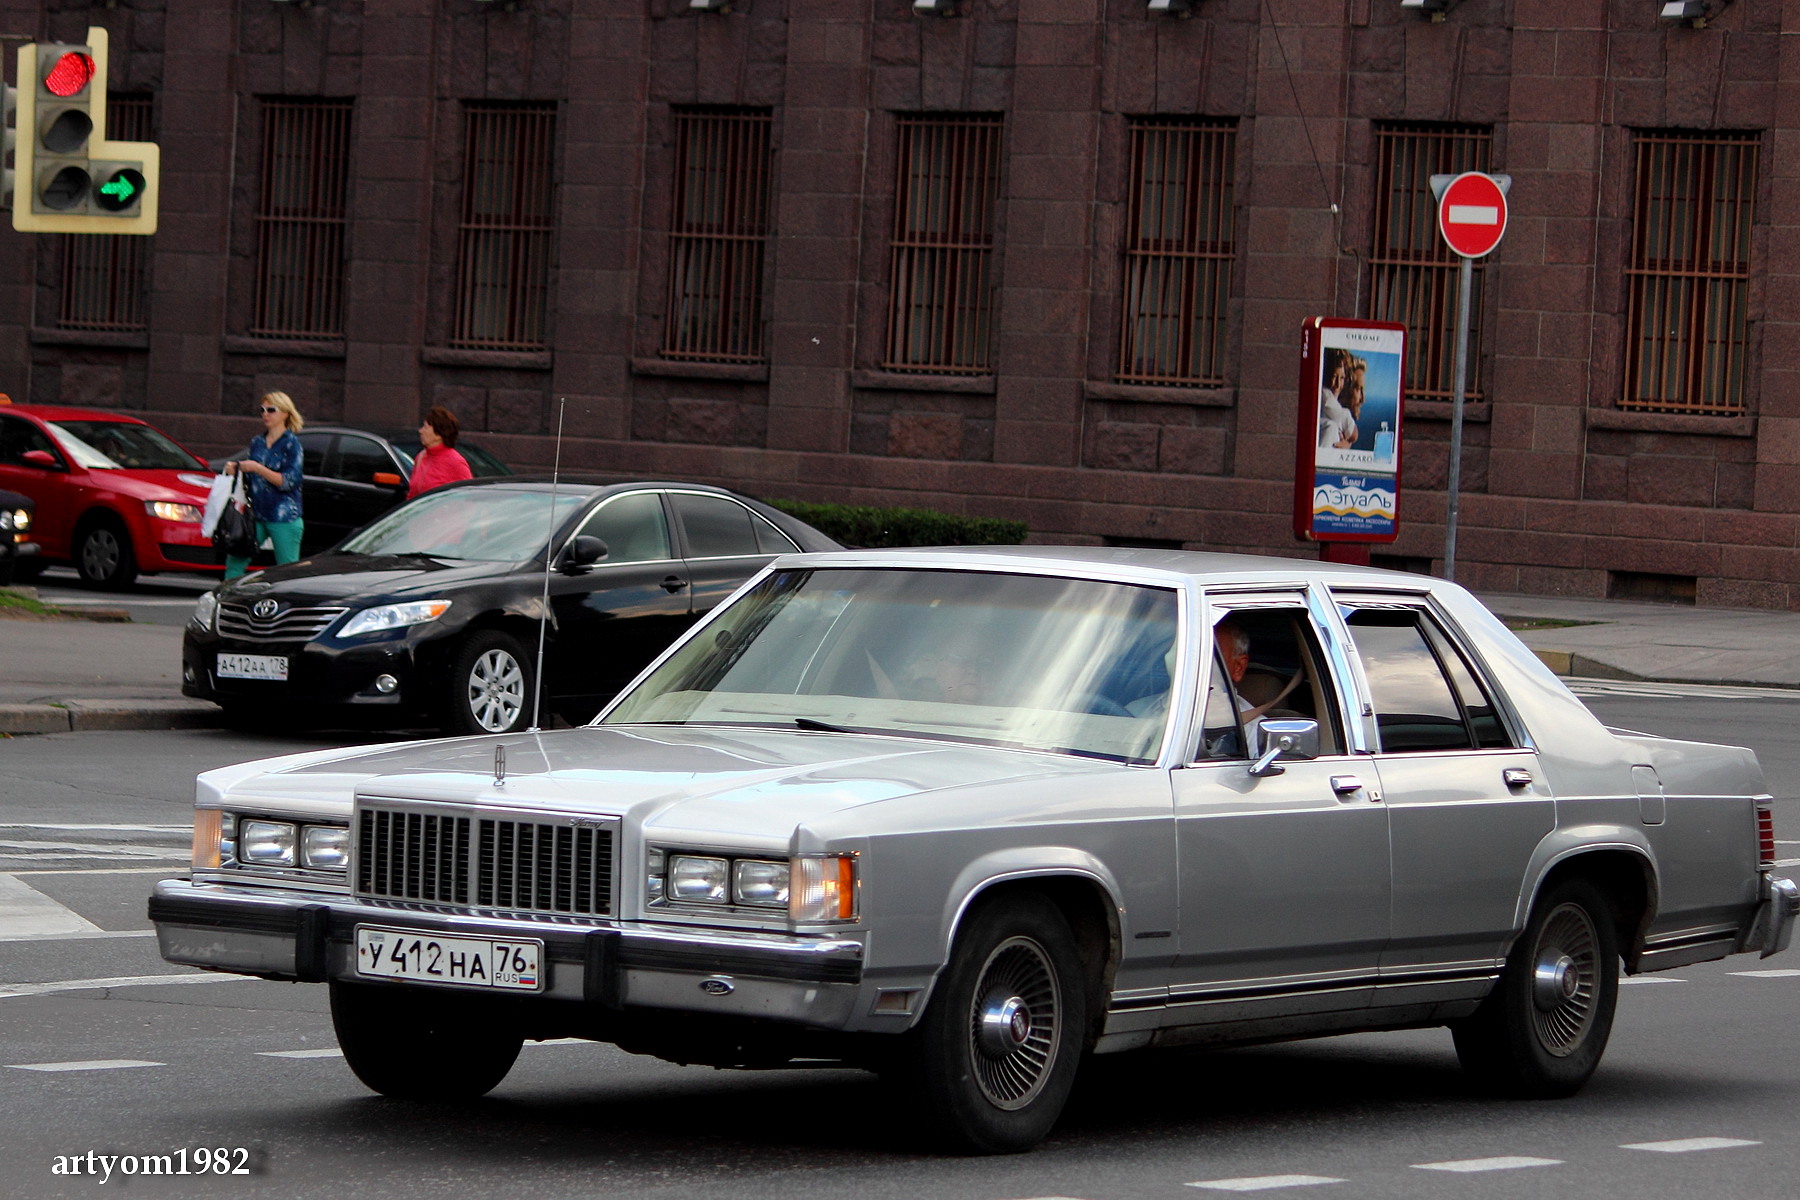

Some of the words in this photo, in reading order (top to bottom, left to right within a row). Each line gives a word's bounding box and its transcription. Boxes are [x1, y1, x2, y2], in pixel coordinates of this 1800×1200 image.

[1345, 332, 1380, 342] CHROME
[1340, 454, 1373, 463] AZZARO
[496, 946, 527, 973] 76
[495, 972, 518, 983] RUS
